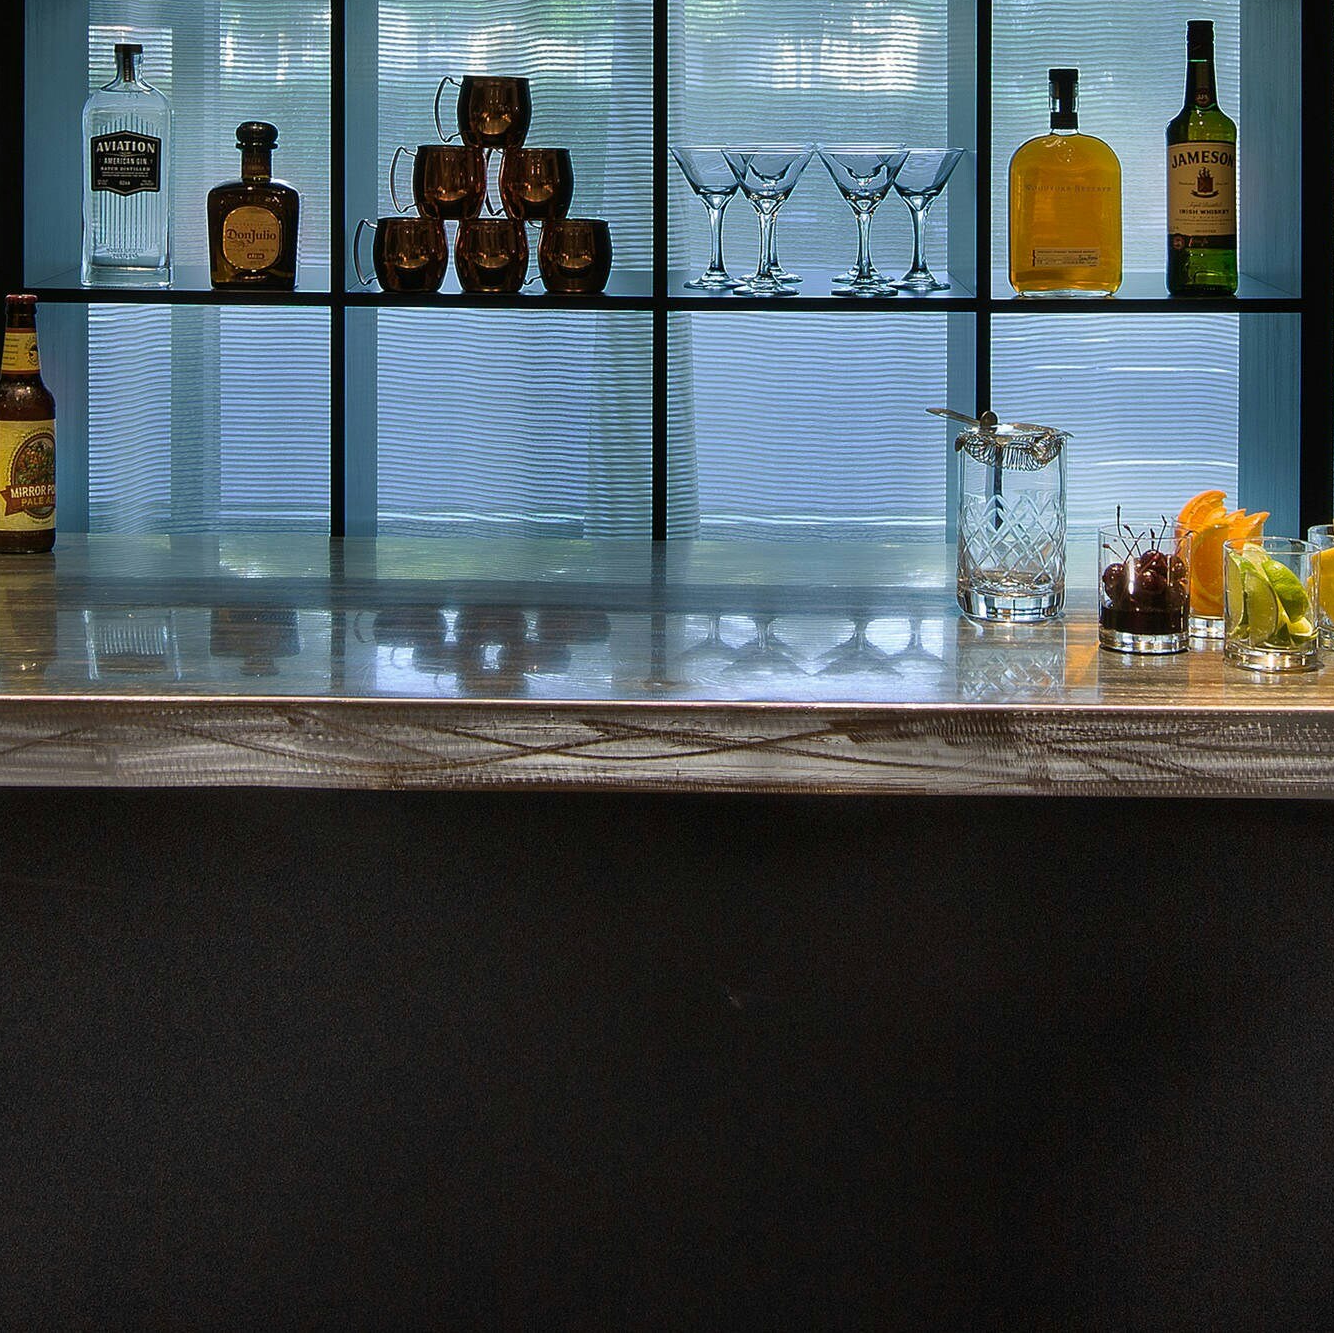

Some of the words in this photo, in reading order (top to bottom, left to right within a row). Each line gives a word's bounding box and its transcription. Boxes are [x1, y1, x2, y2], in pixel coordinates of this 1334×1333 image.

[96, 140, 155, 153] AVIATION
[136, 157, 147, 165] GIN
[1171, 150, 1235, 168] JAMESON
[11, 484, 46, 498] MIRROR
[47, 484, 56, 495] PO
[21, 497, 44, 506] PALE
